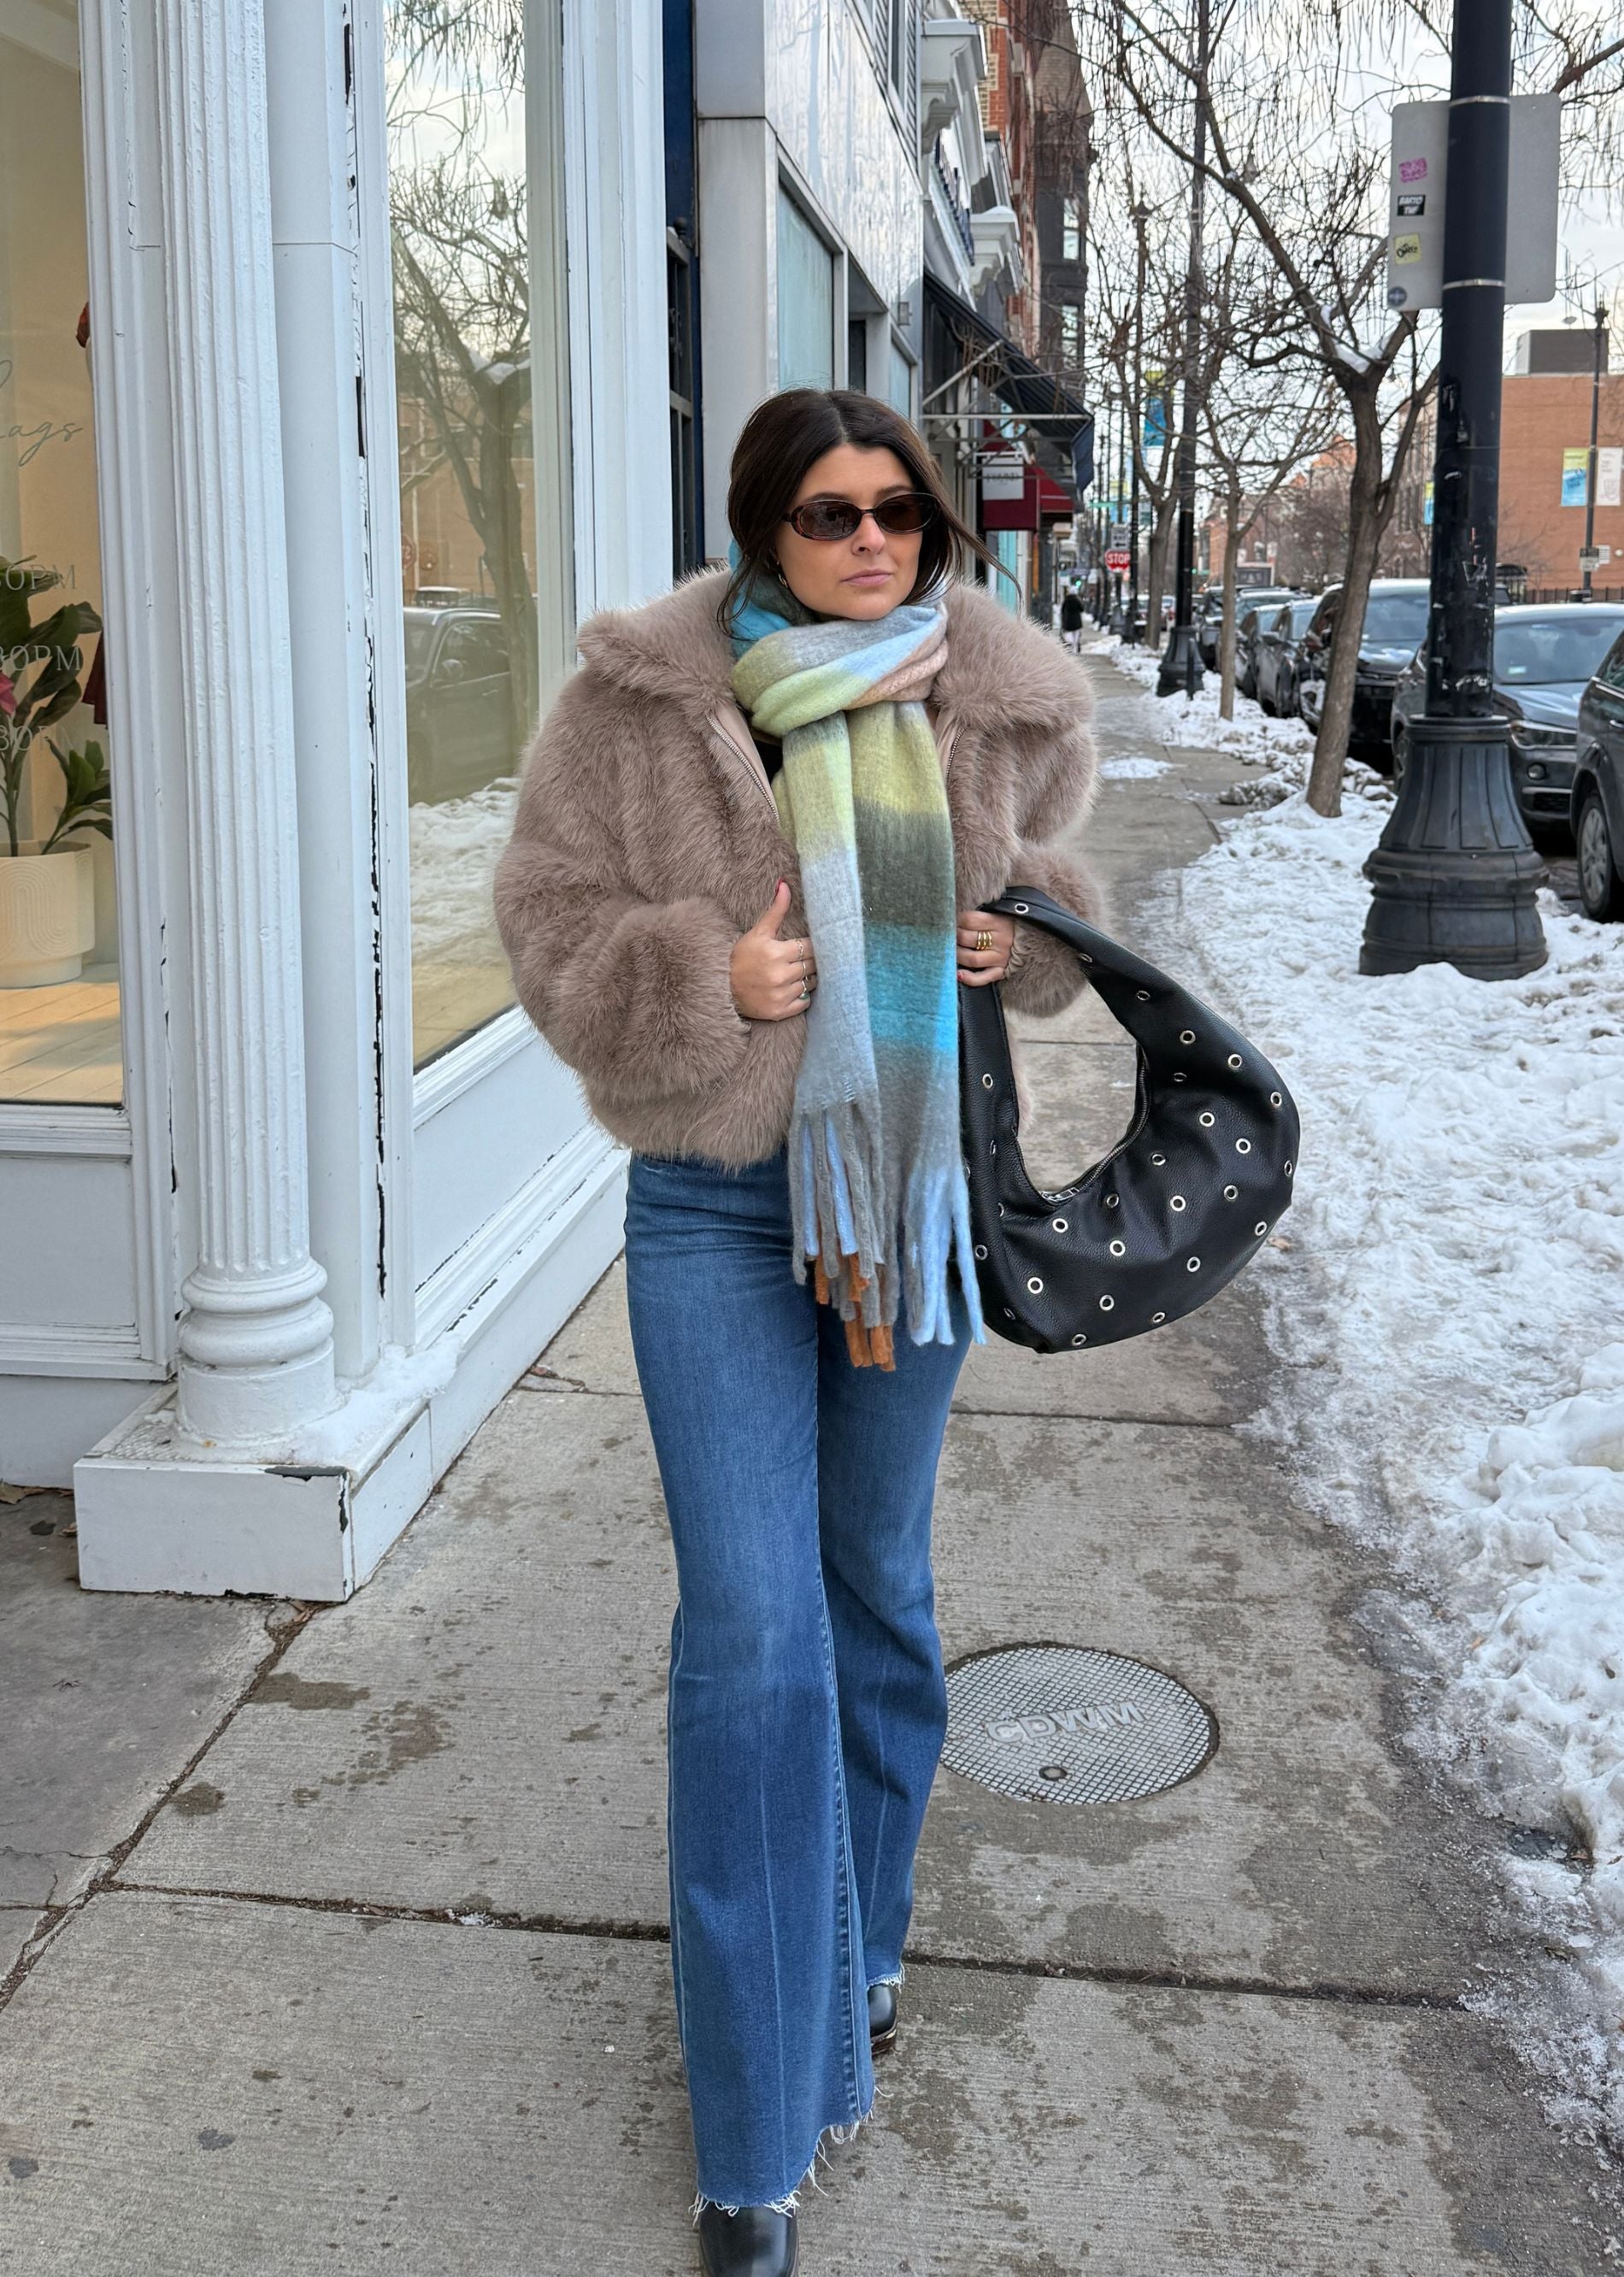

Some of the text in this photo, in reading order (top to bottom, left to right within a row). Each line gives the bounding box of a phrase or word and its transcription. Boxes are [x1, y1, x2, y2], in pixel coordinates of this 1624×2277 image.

[1107, 552, 1131, 564] STOP
[0, 564, 76, 591] 0PM
[986, 1700, 1147, 1744] CDWM
